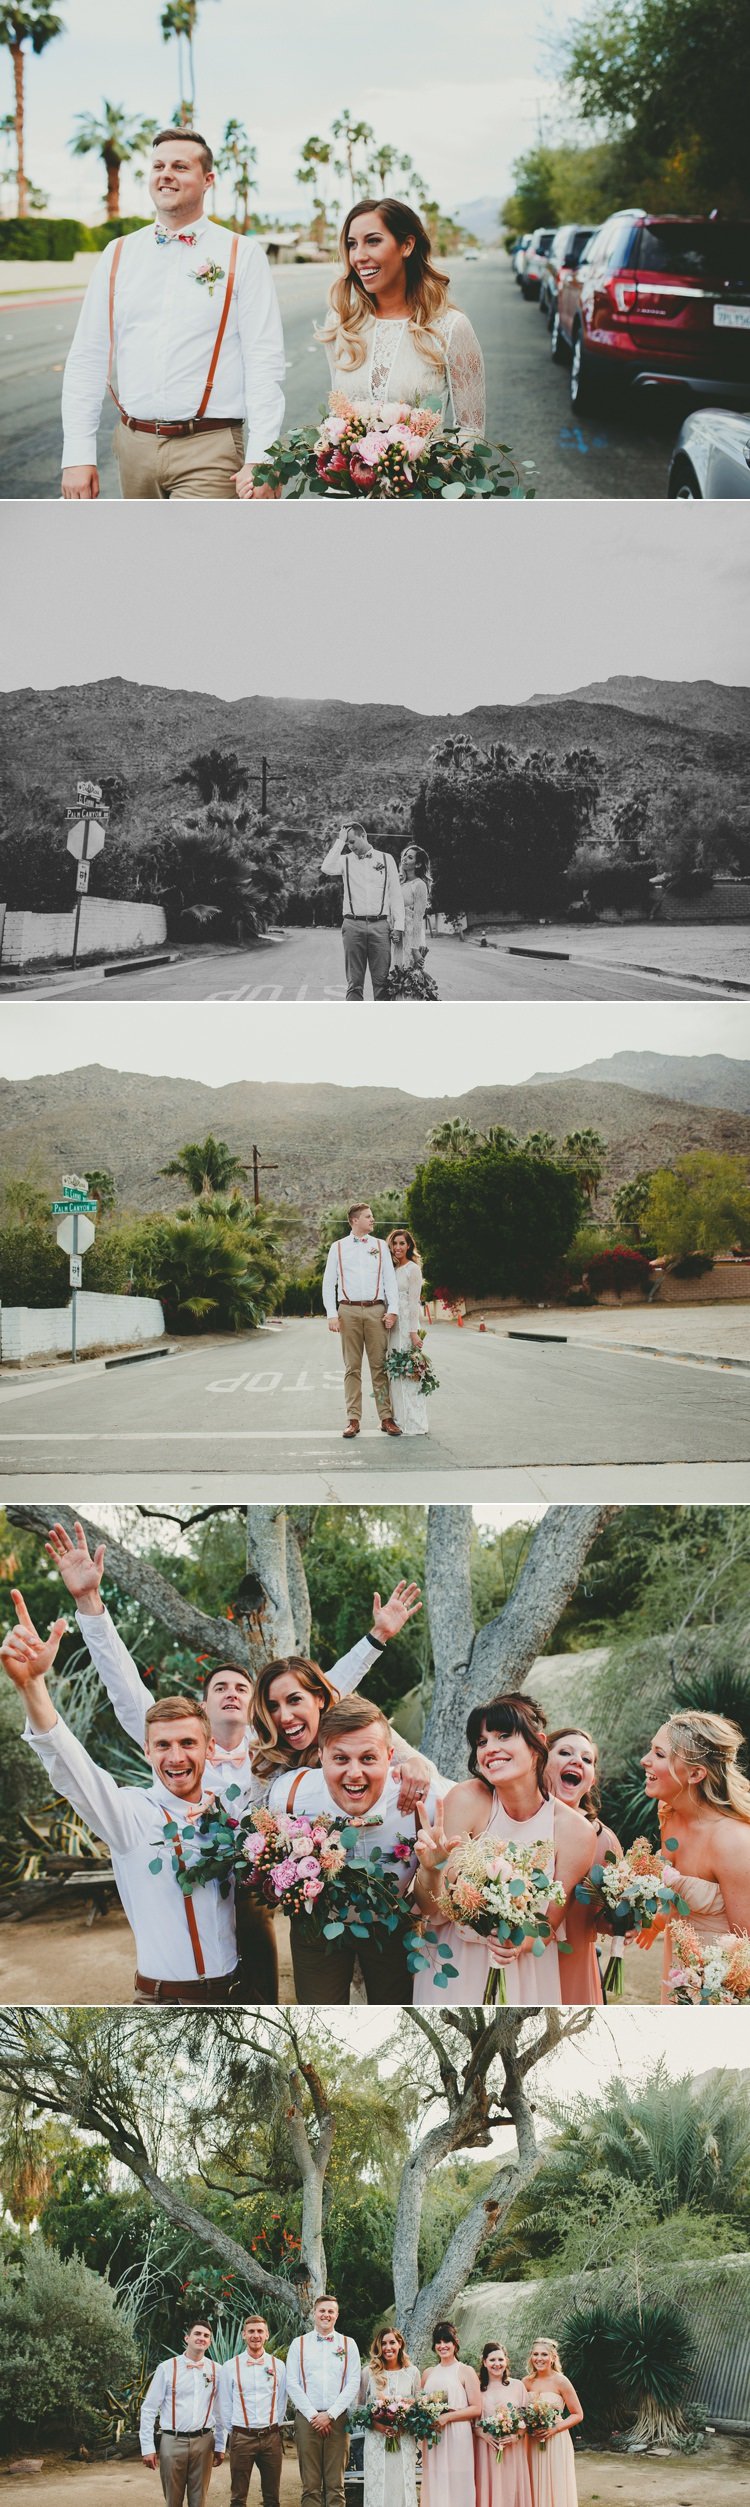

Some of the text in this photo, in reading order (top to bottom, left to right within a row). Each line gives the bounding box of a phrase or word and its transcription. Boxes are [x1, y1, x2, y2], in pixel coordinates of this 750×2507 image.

[66, 809, 81, 818] PALM
[82, 808, 102, 818] CANYON
[54, 1203, 69, 1212] PALM
[70, 1202, 90, 1212] CANYON
